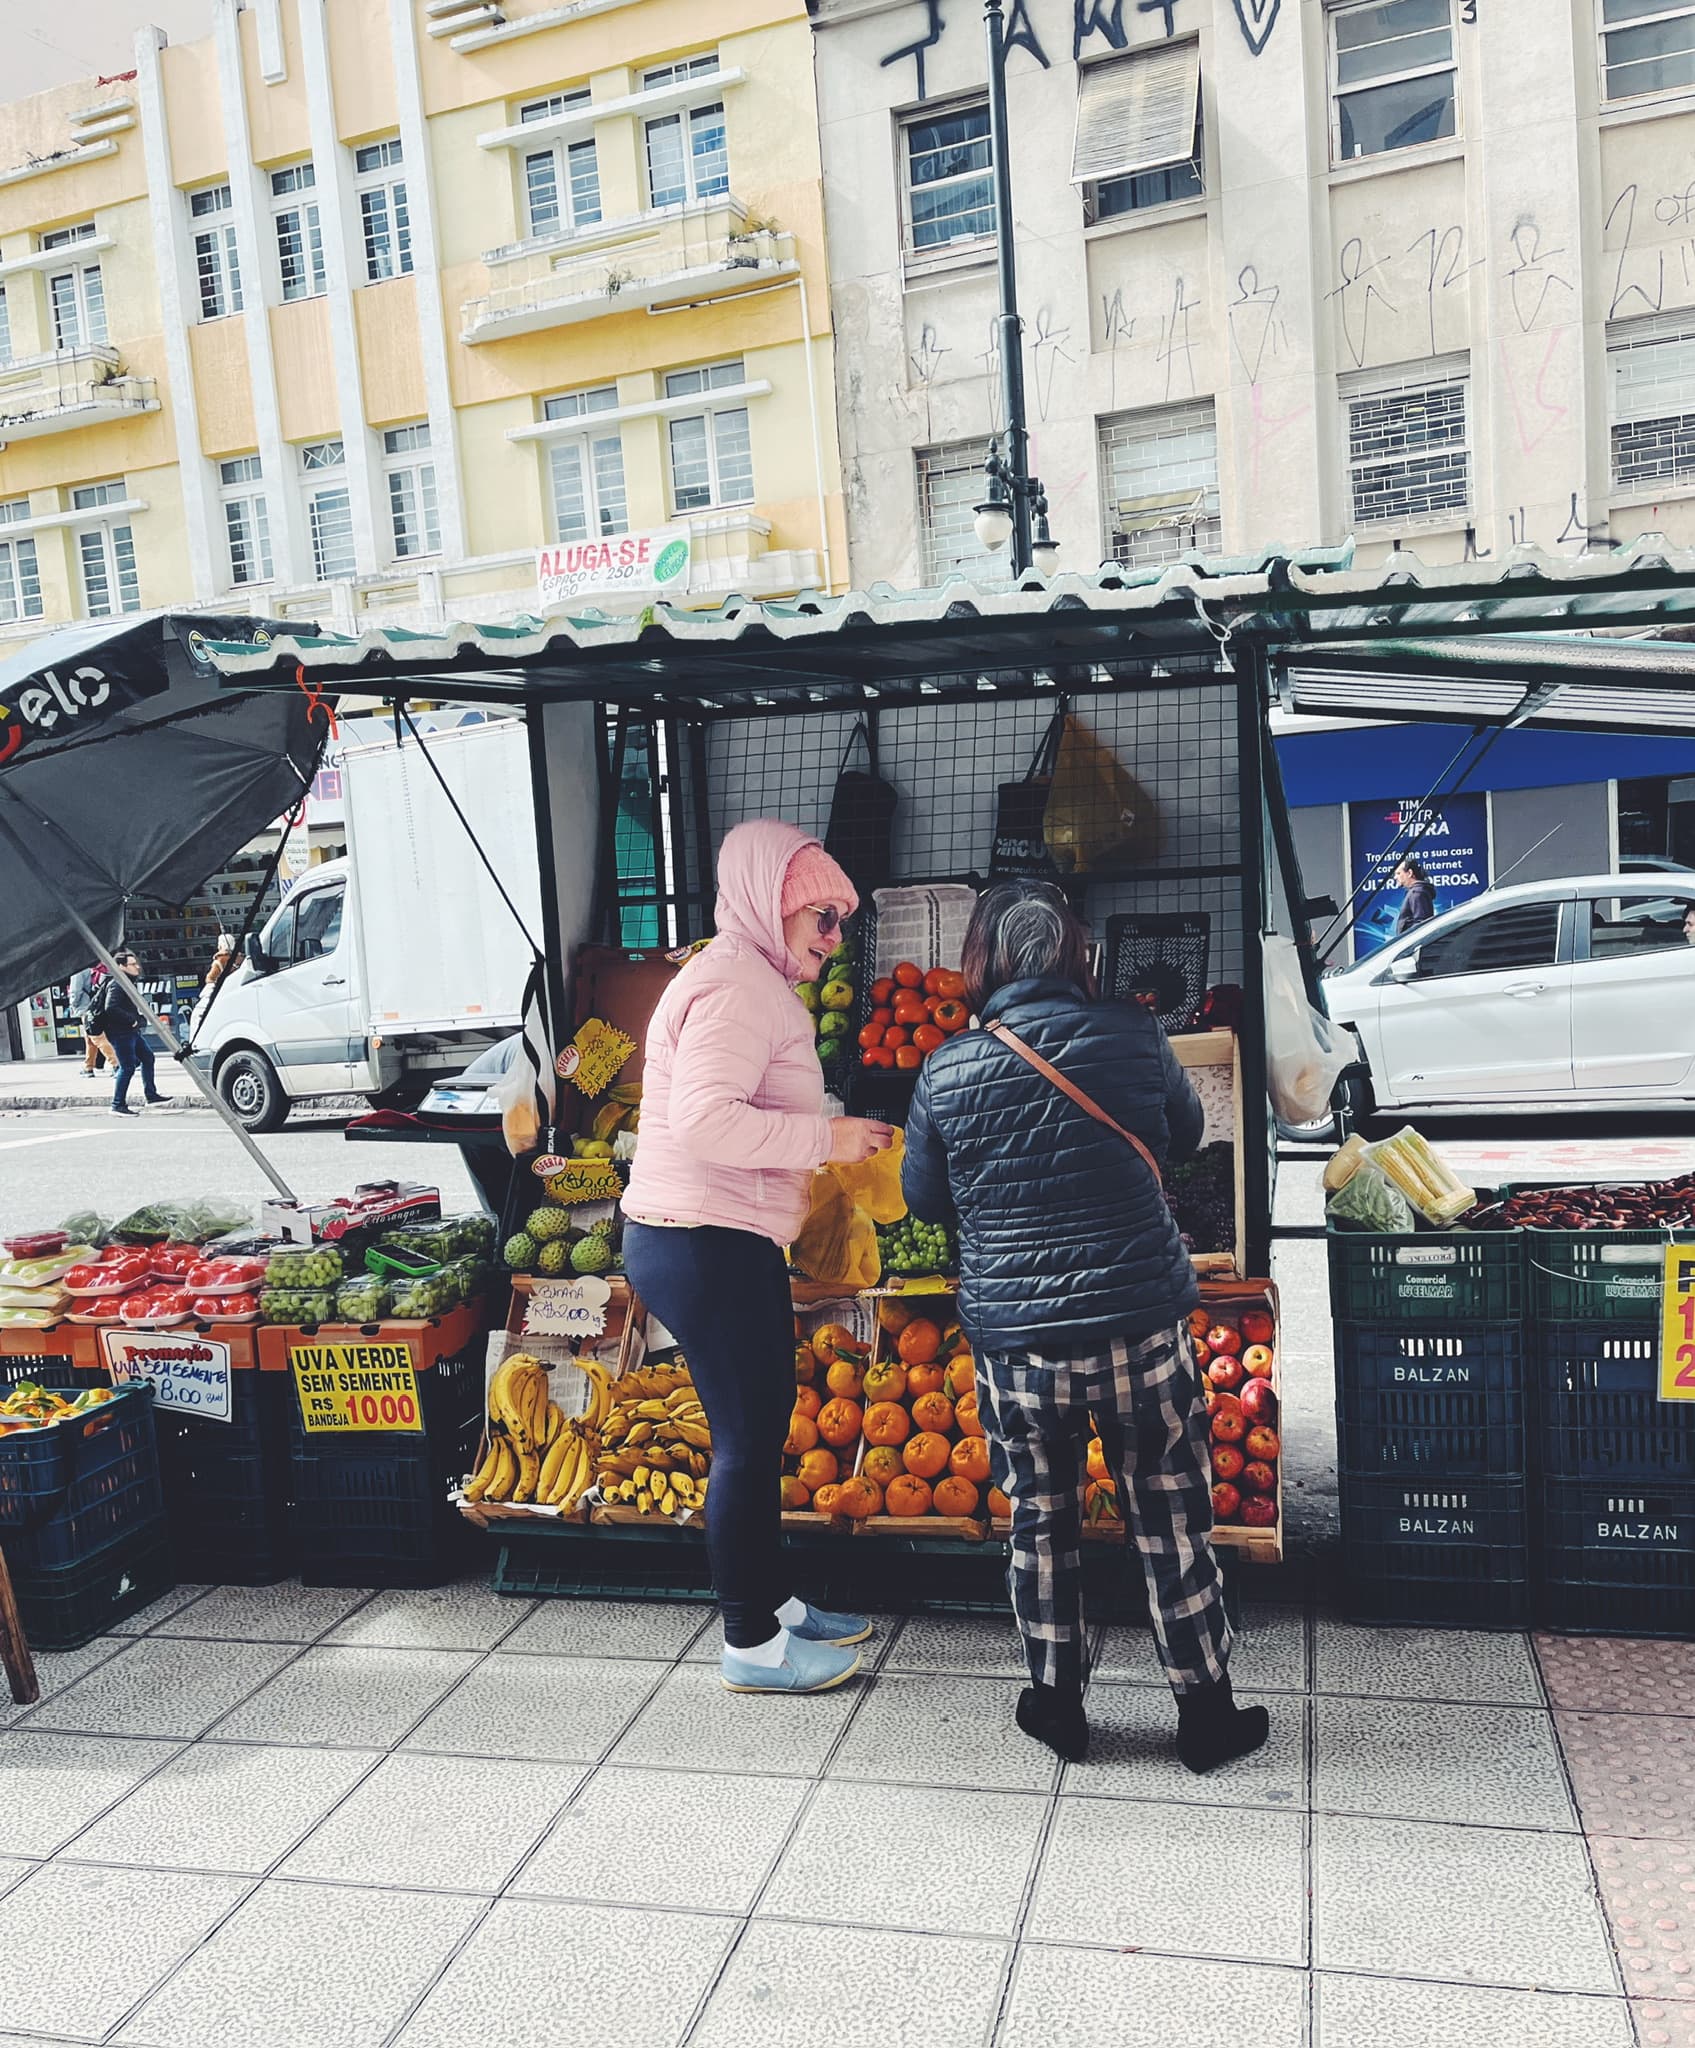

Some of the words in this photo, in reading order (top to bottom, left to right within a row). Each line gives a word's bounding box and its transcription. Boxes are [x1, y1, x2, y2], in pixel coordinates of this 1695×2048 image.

[540, 538, 650, 579] ALUGA-SE
[606, 565, 634, 580] 250
[19, 666, 110, 727] elo
[1398, 800, 1420, 811] TIM
[1365, 851, 1420, 863] Transfome
[1423, 851, 1429, 859] a
[1431, 849, 1449, 858] sua
[1451, 848, 1473, 857] casa
[1423, 860, 1463, 871] internet
[558, 1047, 577, 1073] OFERTA
[535, 1156, 563, 1173] OFERTA
[1405, 1274, 1447, 1285] Comercial
[1612, 1274, 1656, 1286] Comercial
[1398, 1285, 1454, 1298] LUCELMAR
[1605, 1285, 1663, 1298] LUCELMAR
[123, 1344, 213, 1364] Promoção
[295, 1349, 339, 1371] UVA
[341, 1347, 409, 1370] VERDE
[112, 1360, 142, 1375] UVA
[144, 1358, 171, 1377] SEM
[172, 1363, 228, 1385] SEMENTE
[1394, 1367, 1470, 1383] BALZAN
[301, 1374, 335, 1393] SEM
[338, 1373, 413, 1392] SEMENTE
[311, 1397, 333, 1413] R$
[308, 1413, 350, 1427] BANDEJA
[1399, 1518, 1474, 1535] BALZAN
[1598, 1523, 1677, 1540] BALZAN
